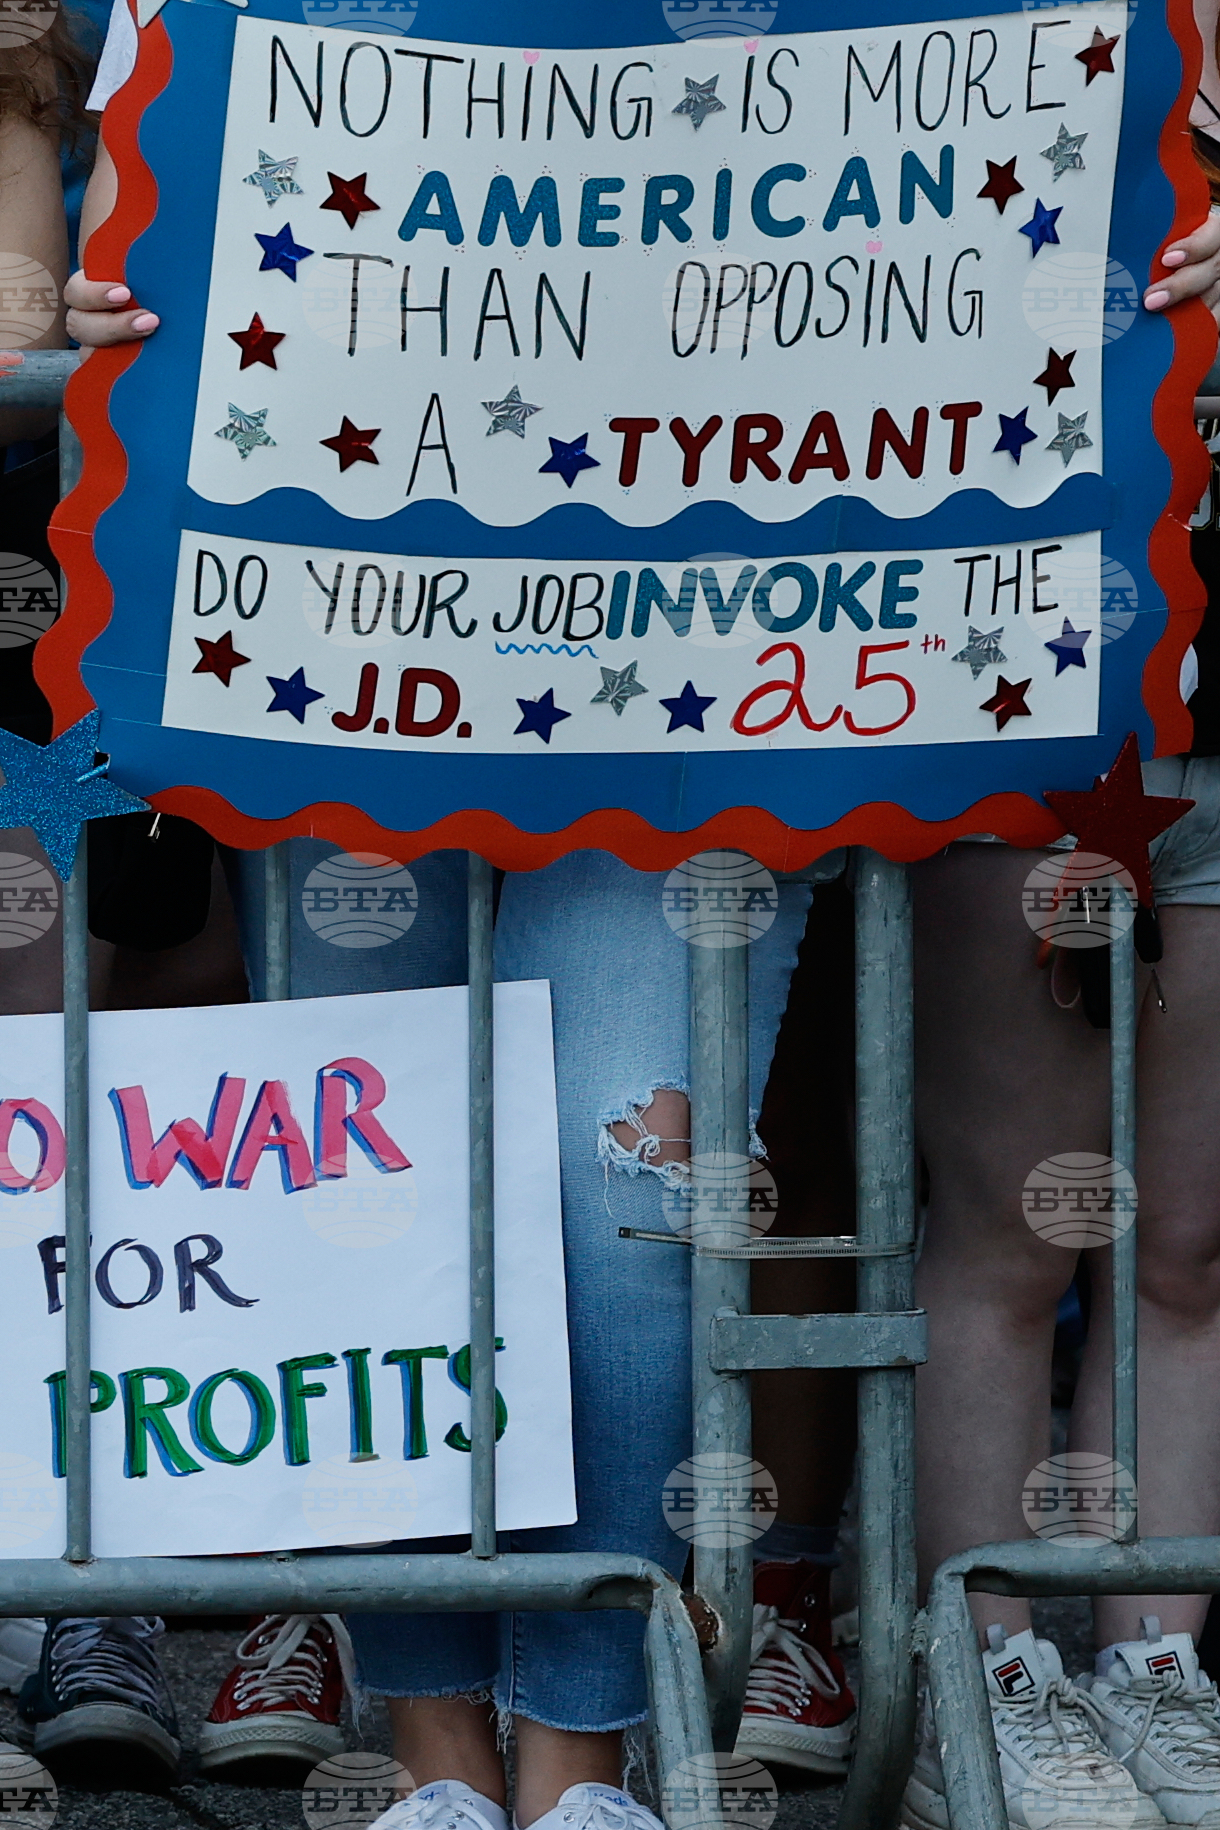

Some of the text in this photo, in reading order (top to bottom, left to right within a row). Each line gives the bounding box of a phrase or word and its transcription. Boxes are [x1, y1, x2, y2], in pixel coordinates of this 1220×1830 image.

[268, 20, 1073, 142] NOTHING IS MORE
[397, 144, 955, 248] AMERICAN
[323, 246, 984, 362] THAN OPPOSING
[404, 392, 984, 498] A TYRANT
[193, 548, 606, 642] DO YOUR JOB
[604, 543, 1063, 641] INVOKE THE
[331, 661, 473, 739] J.D.
[108, 1055, 414, 1195] WAR
[37, 1233, 260, 1316] FOR
[46, 1336, 510, 1480] PROFITS
